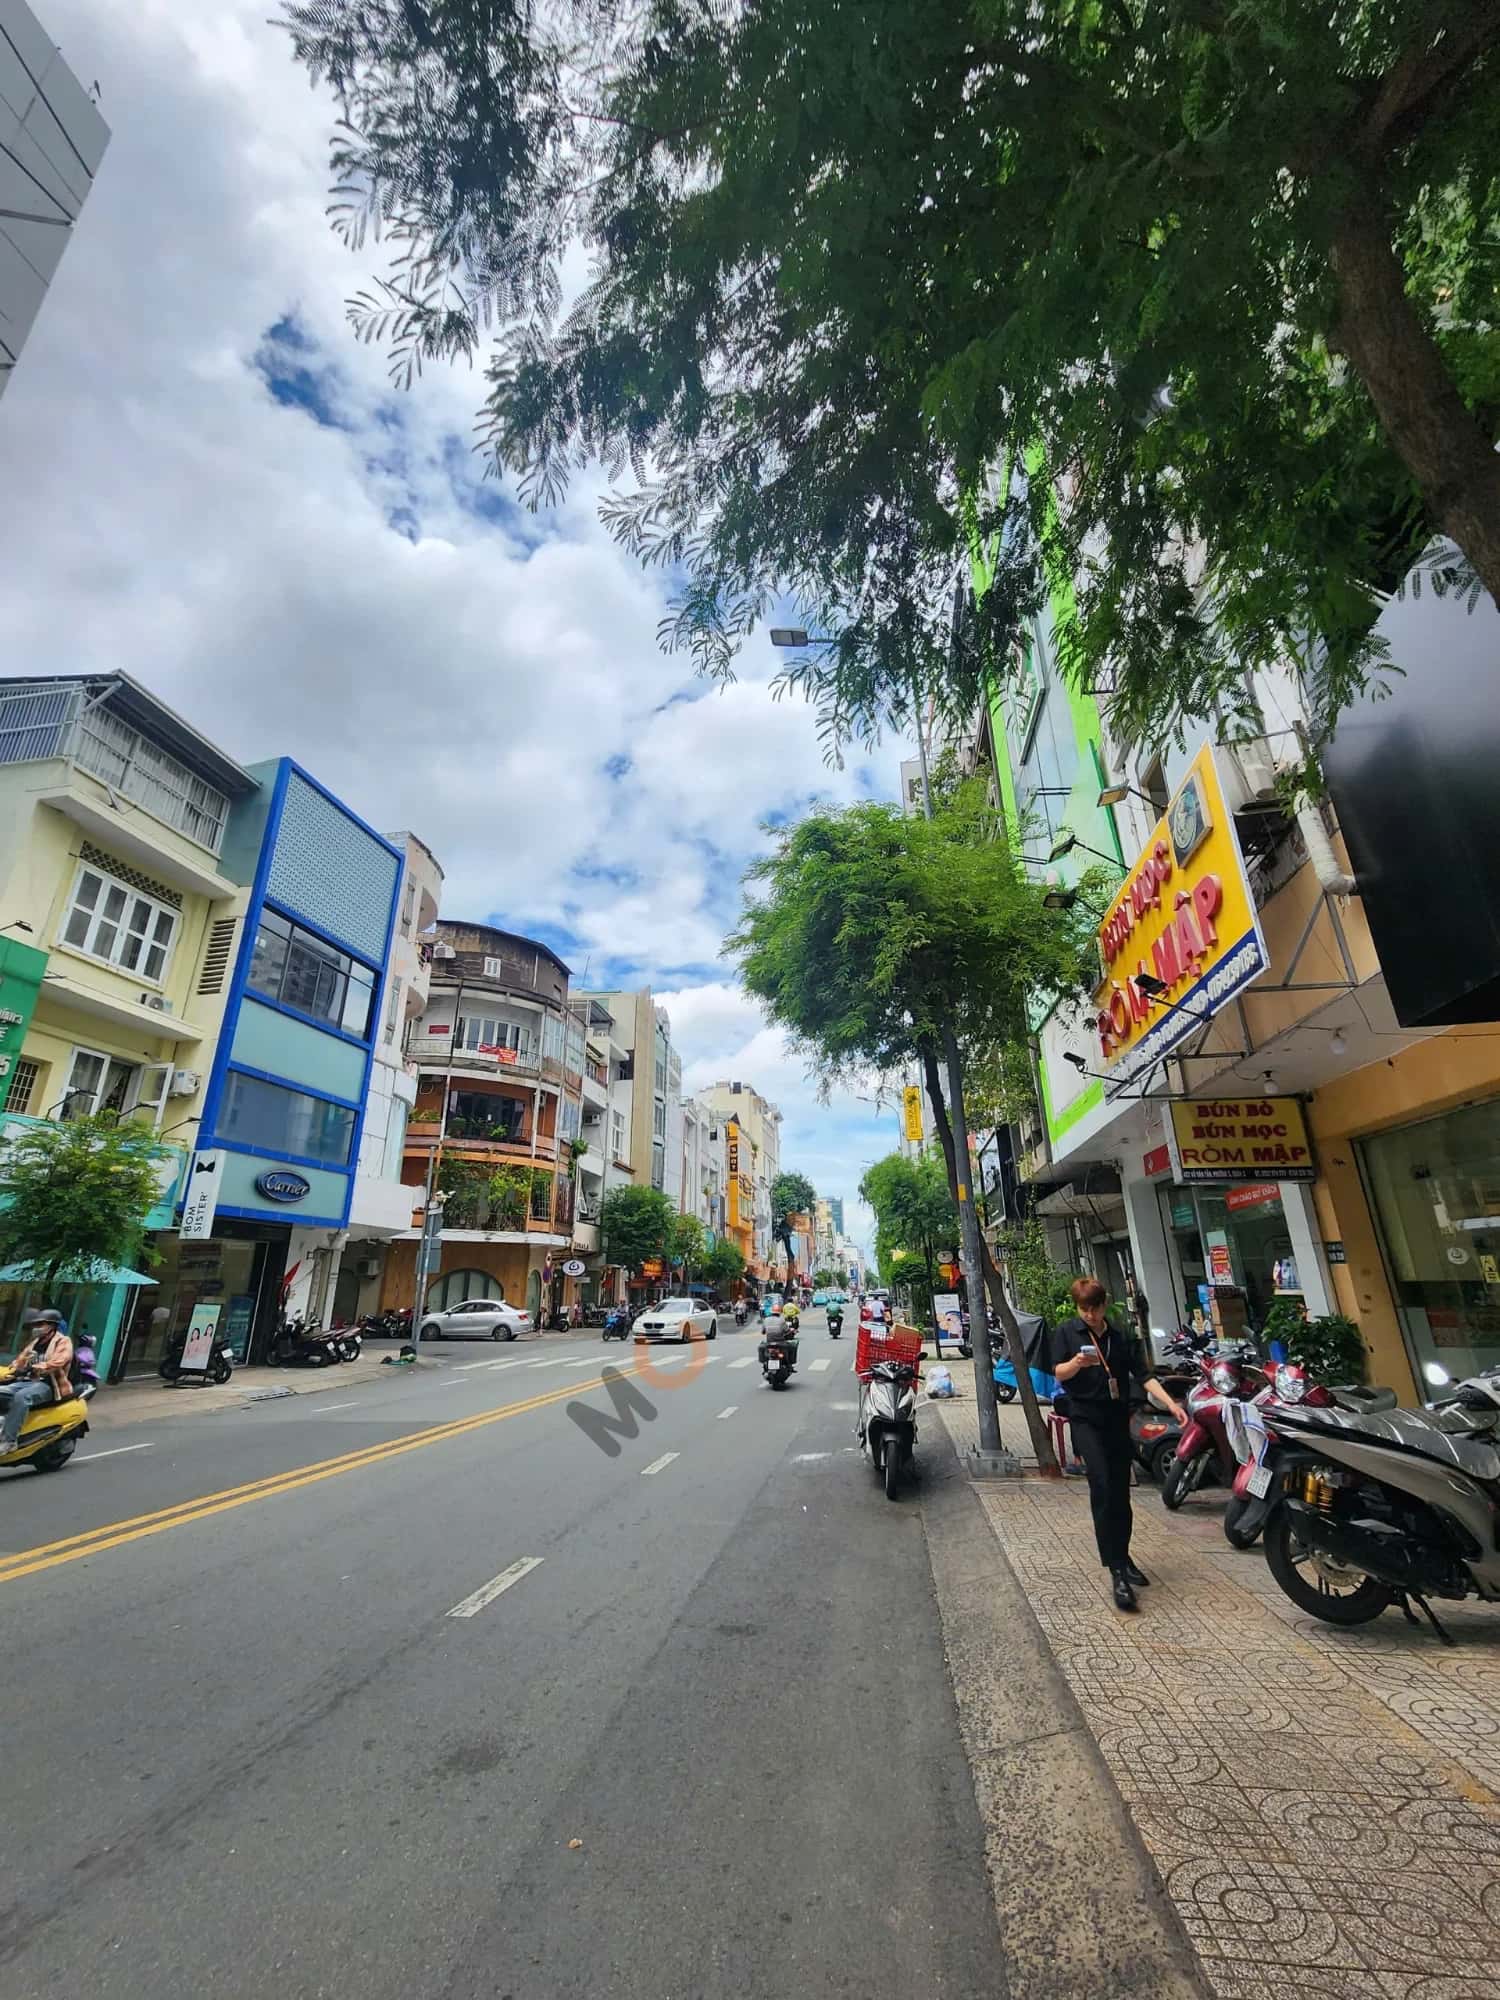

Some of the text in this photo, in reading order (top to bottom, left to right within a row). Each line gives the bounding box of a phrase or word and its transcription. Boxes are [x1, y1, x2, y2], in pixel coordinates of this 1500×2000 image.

[1152, 874, 1222, 994] MẬP
[1197, 1101, 1273, 1118] BÚN BÒ
[1192, 1122, 1287, 1140] BÚN MỌC
[1182, 1144, 1306, 1164] RÒM MẬP
[267, 1174, 309, 1196] Carrier
[184, 1206, 196, 1232] BOM
